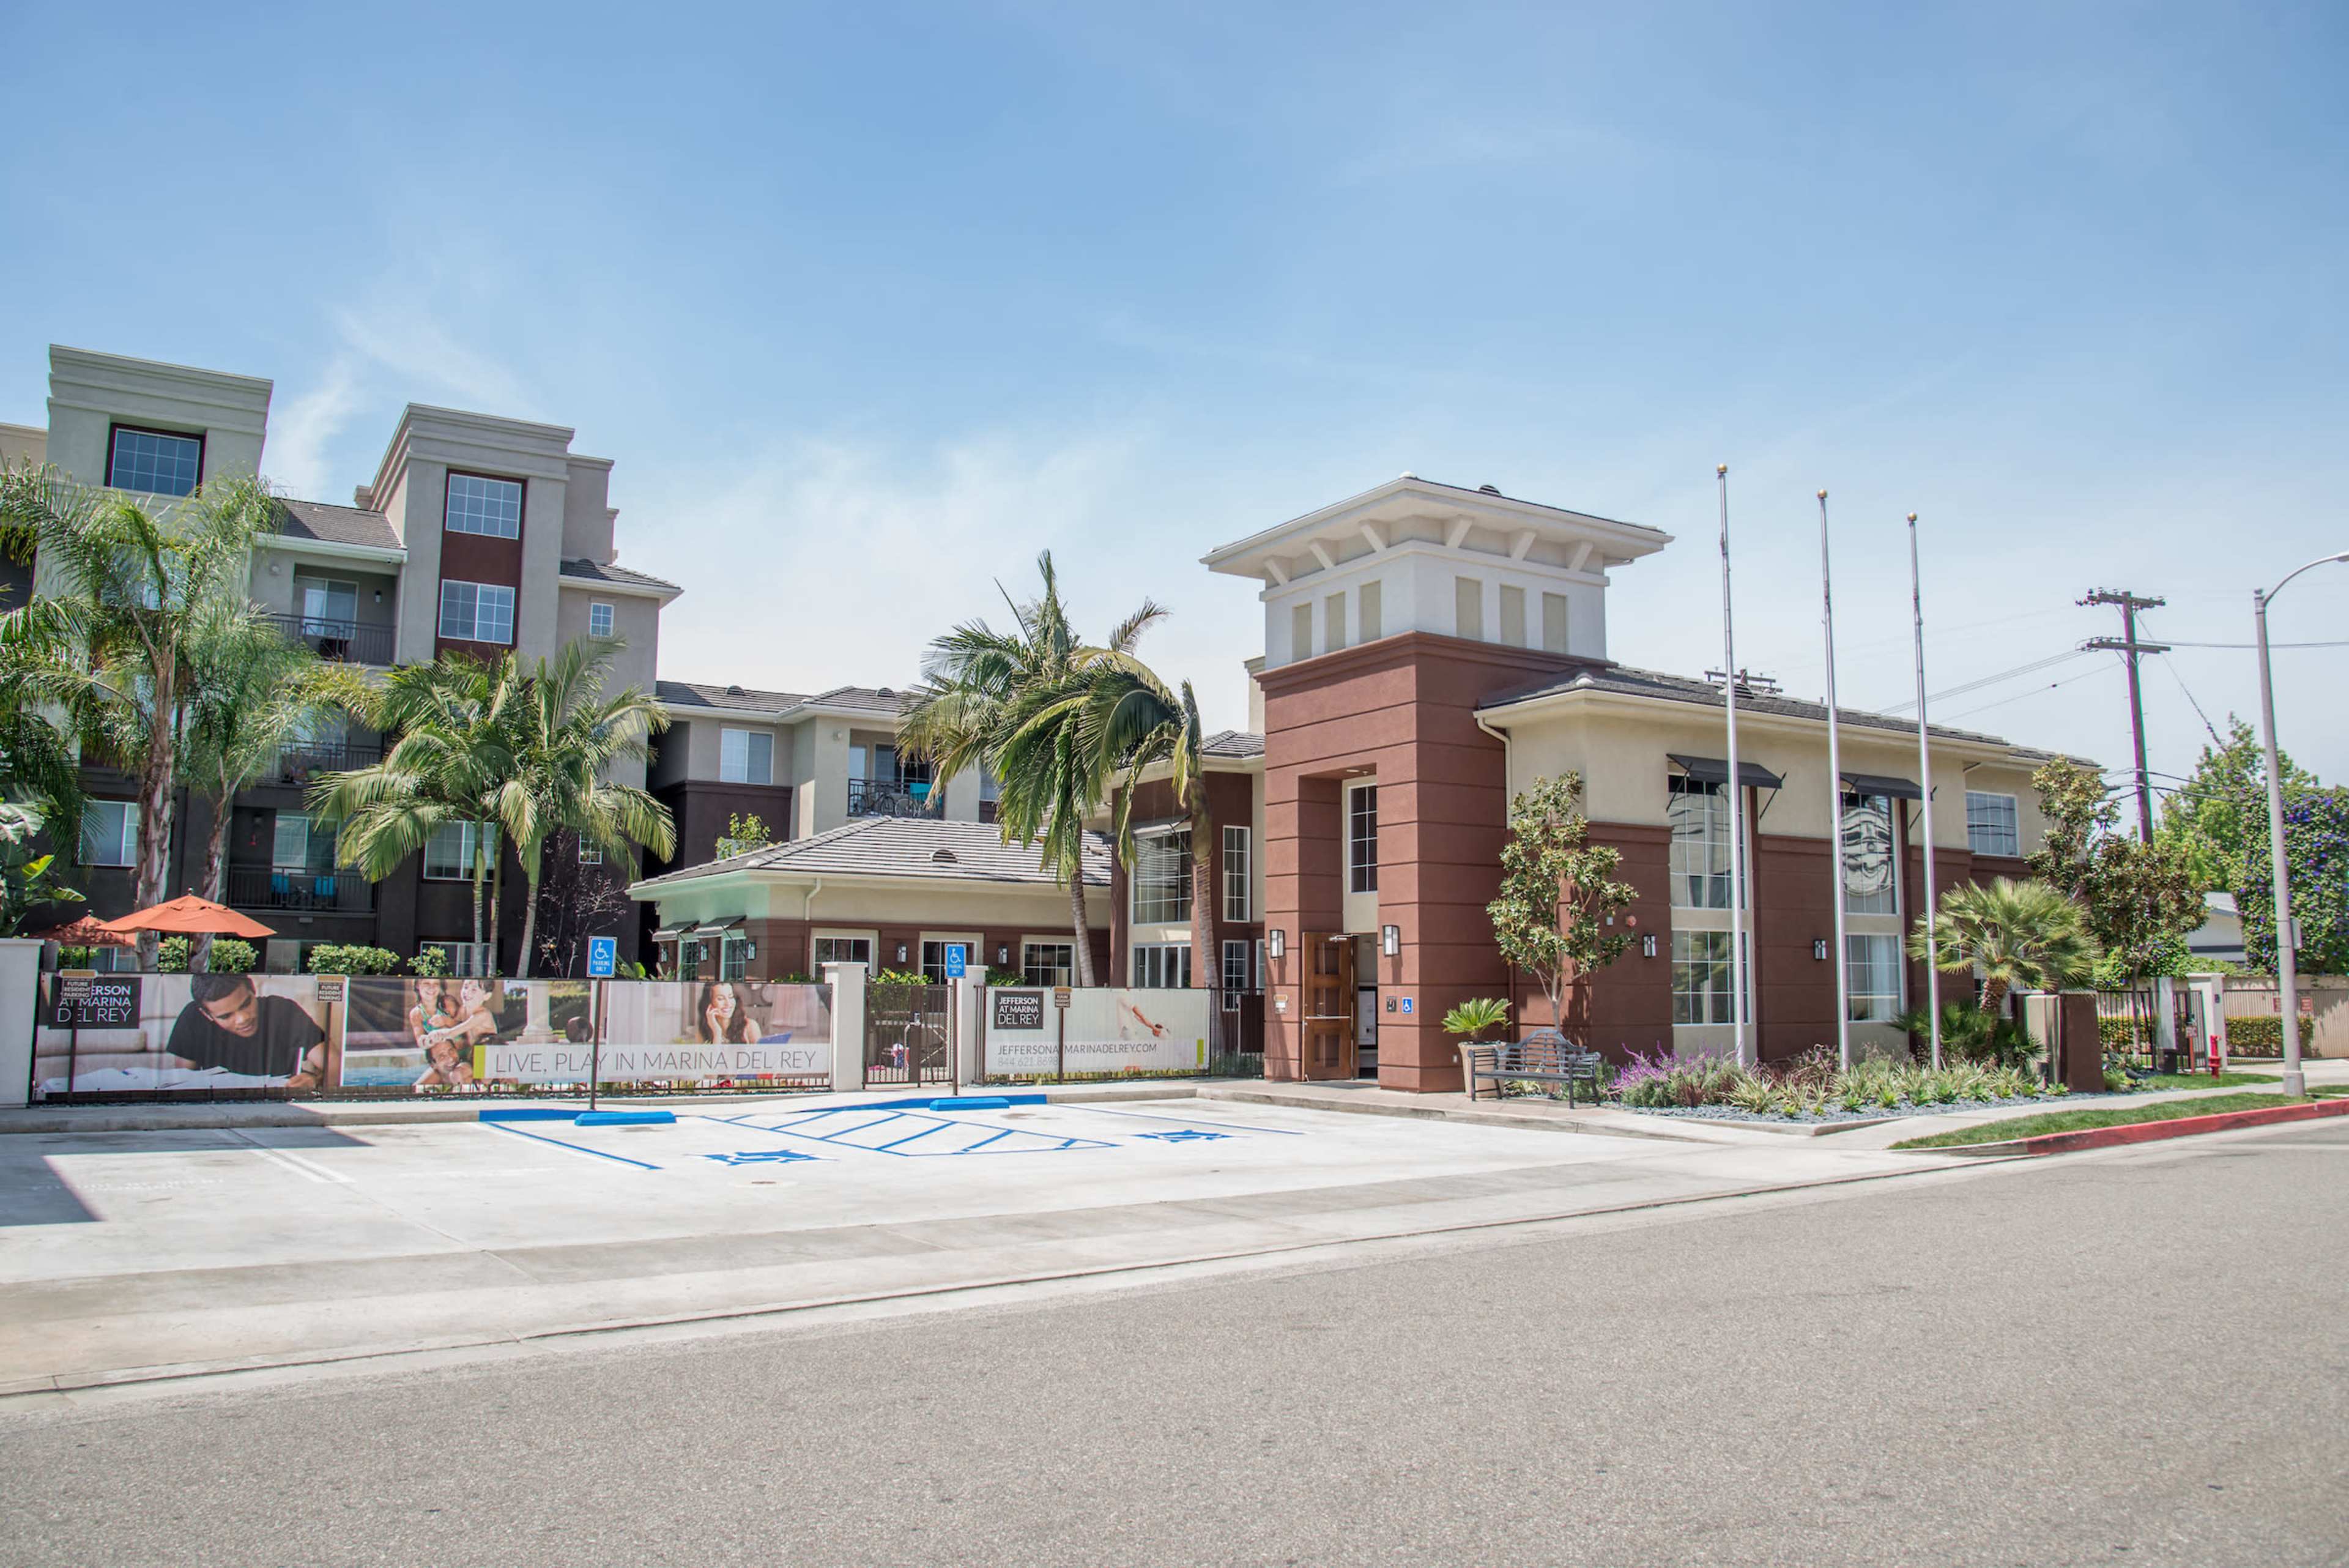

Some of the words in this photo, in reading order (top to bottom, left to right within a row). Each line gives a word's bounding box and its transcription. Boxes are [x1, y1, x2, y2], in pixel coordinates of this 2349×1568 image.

[79, 997, 132, 1006] MARINA
[97, 1008, 132, 1022] REY
[998, 1014, 1017, 1024] DEL
[1019, 1014, 1039, 1024] REY
[998, 1043, 1157, 1055] JEFFERSONAMARINADELREY.COM
[496, 1053, 547, 1072] LIVE,
[555, 1052, 607, 1071] PLAY
[615, 1052, 634, 1071] IN
[644, 1052, 728, 1070] MARINA
[736, 1051, 773, 1069] DEL
[780, 1050, 817, 1069] REY
